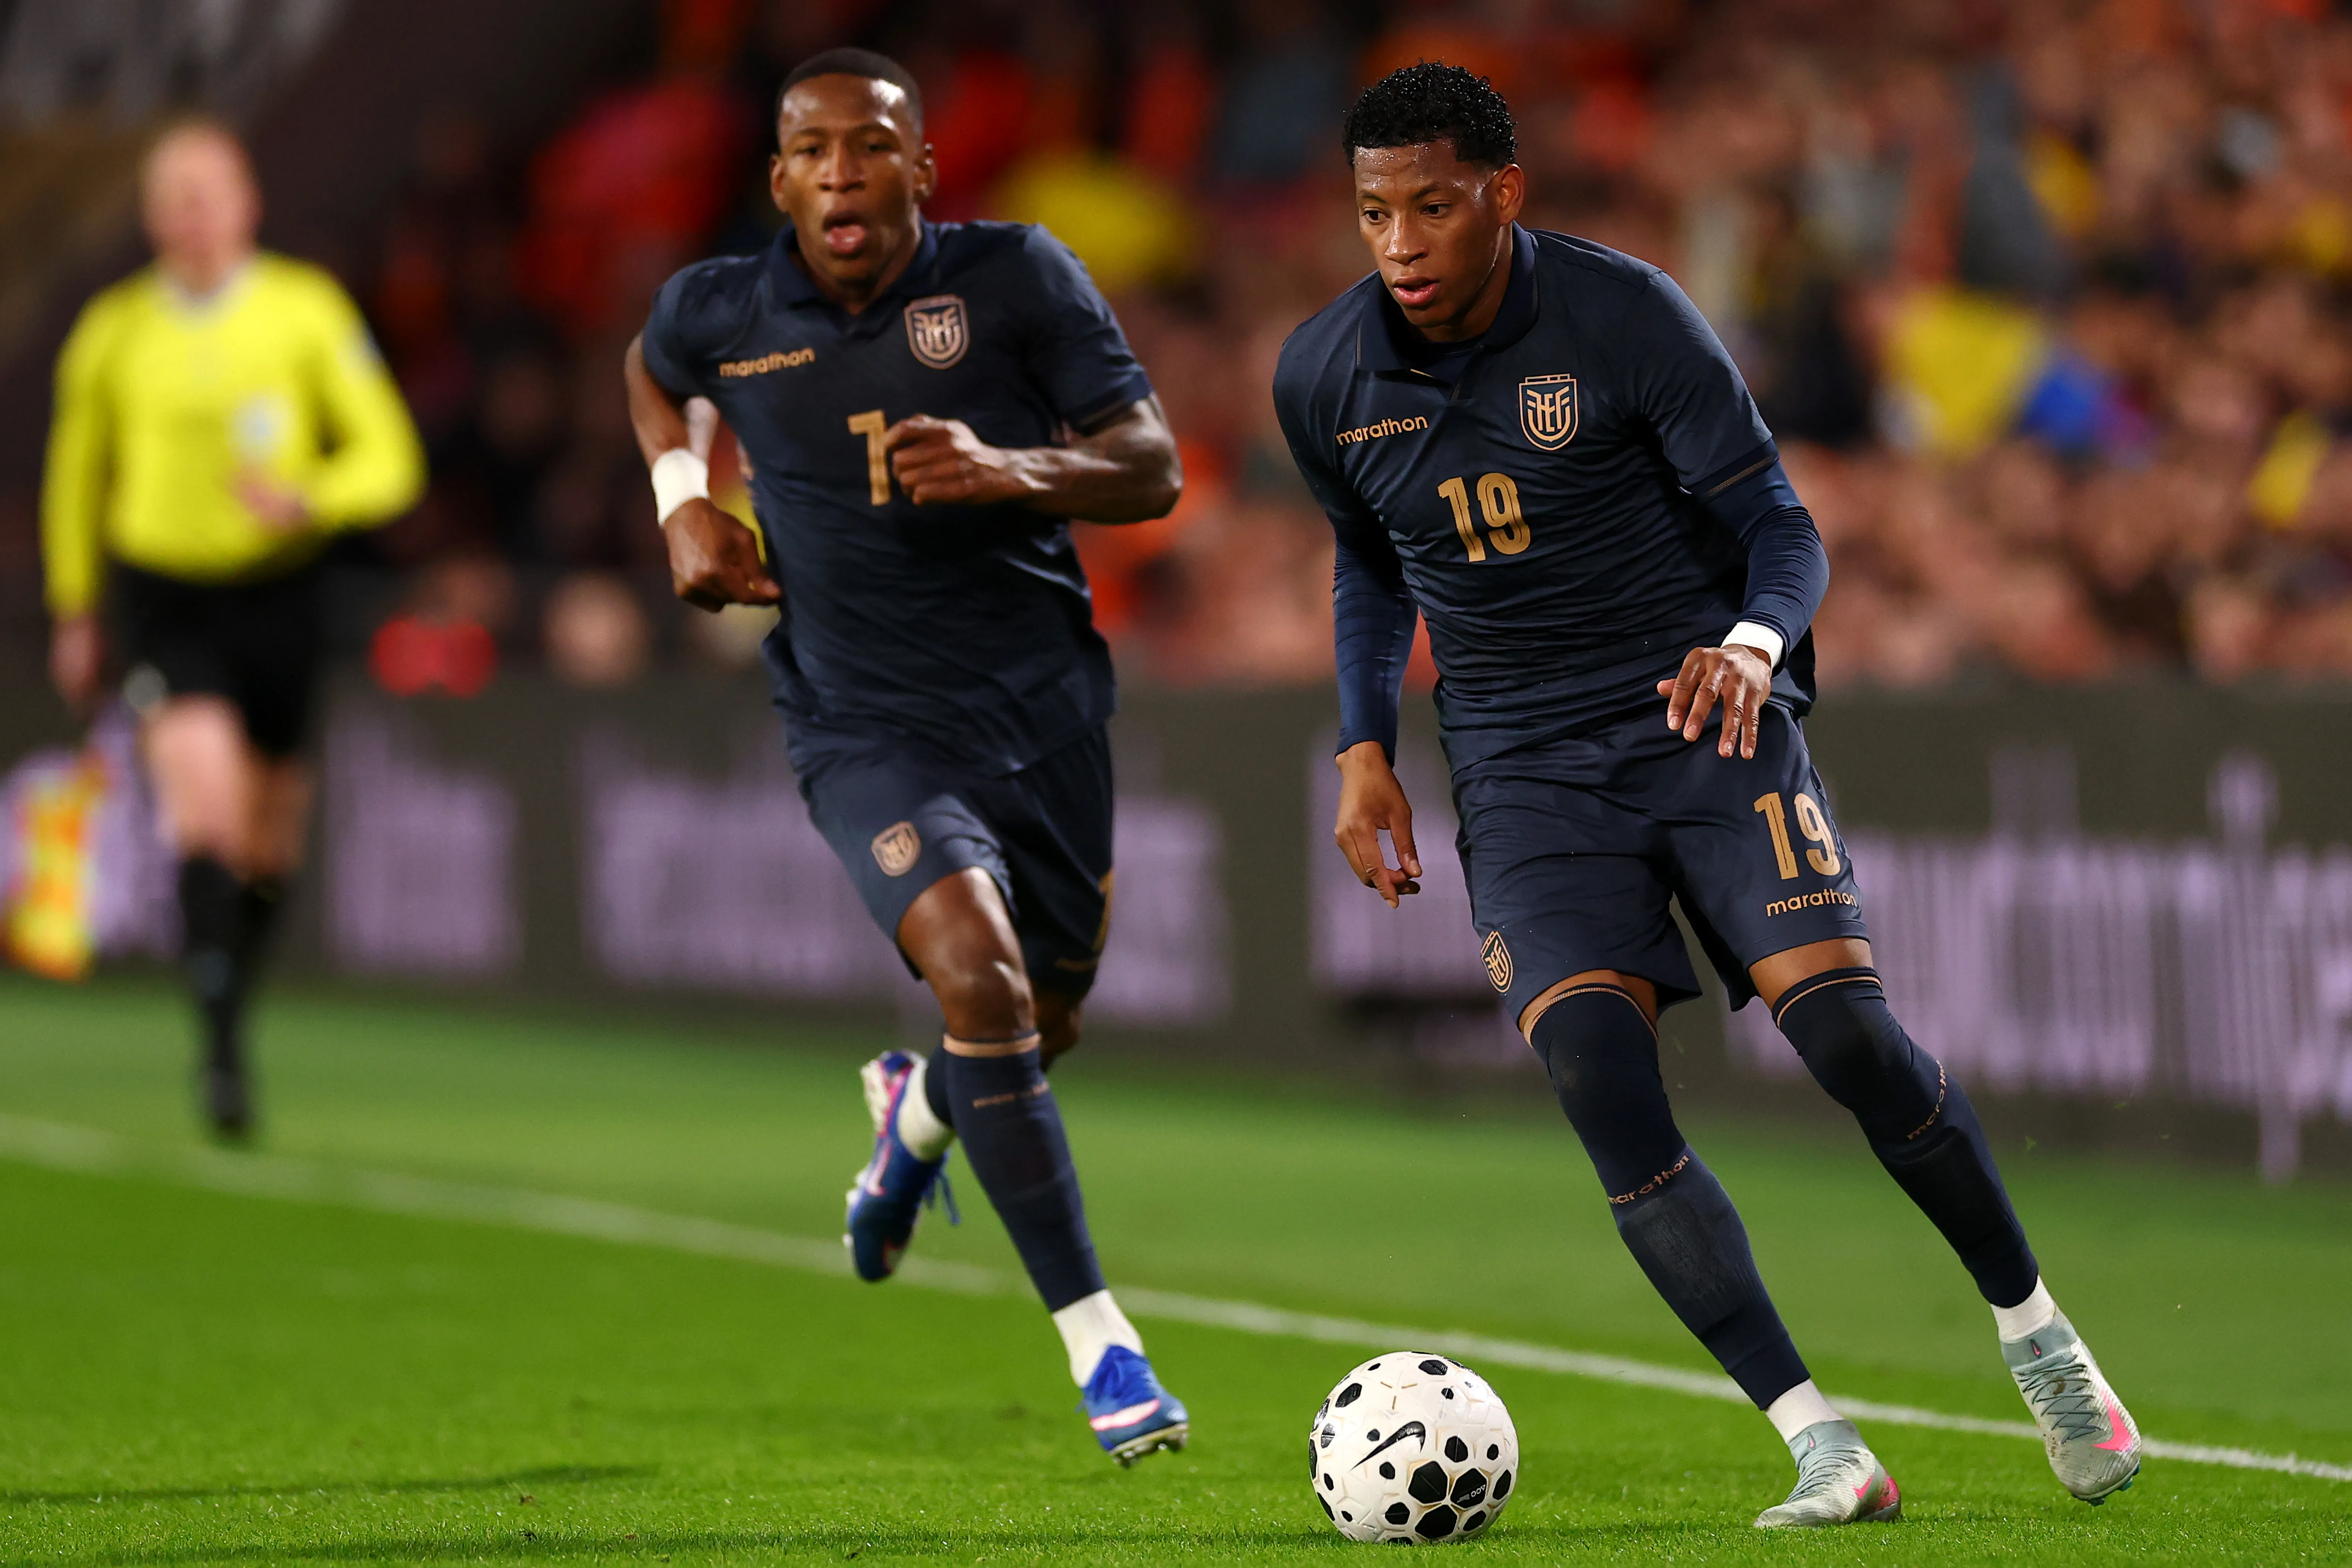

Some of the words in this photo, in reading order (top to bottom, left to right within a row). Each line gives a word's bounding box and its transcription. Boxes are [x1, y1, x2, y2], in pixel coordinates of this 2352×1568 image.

[1336, 416, 1428, 446] marathon
[1437, 473, 1531, 562] 19
[1753, 792, 1840, 879] 19
[1766, 888, 1857, 917] marathon
